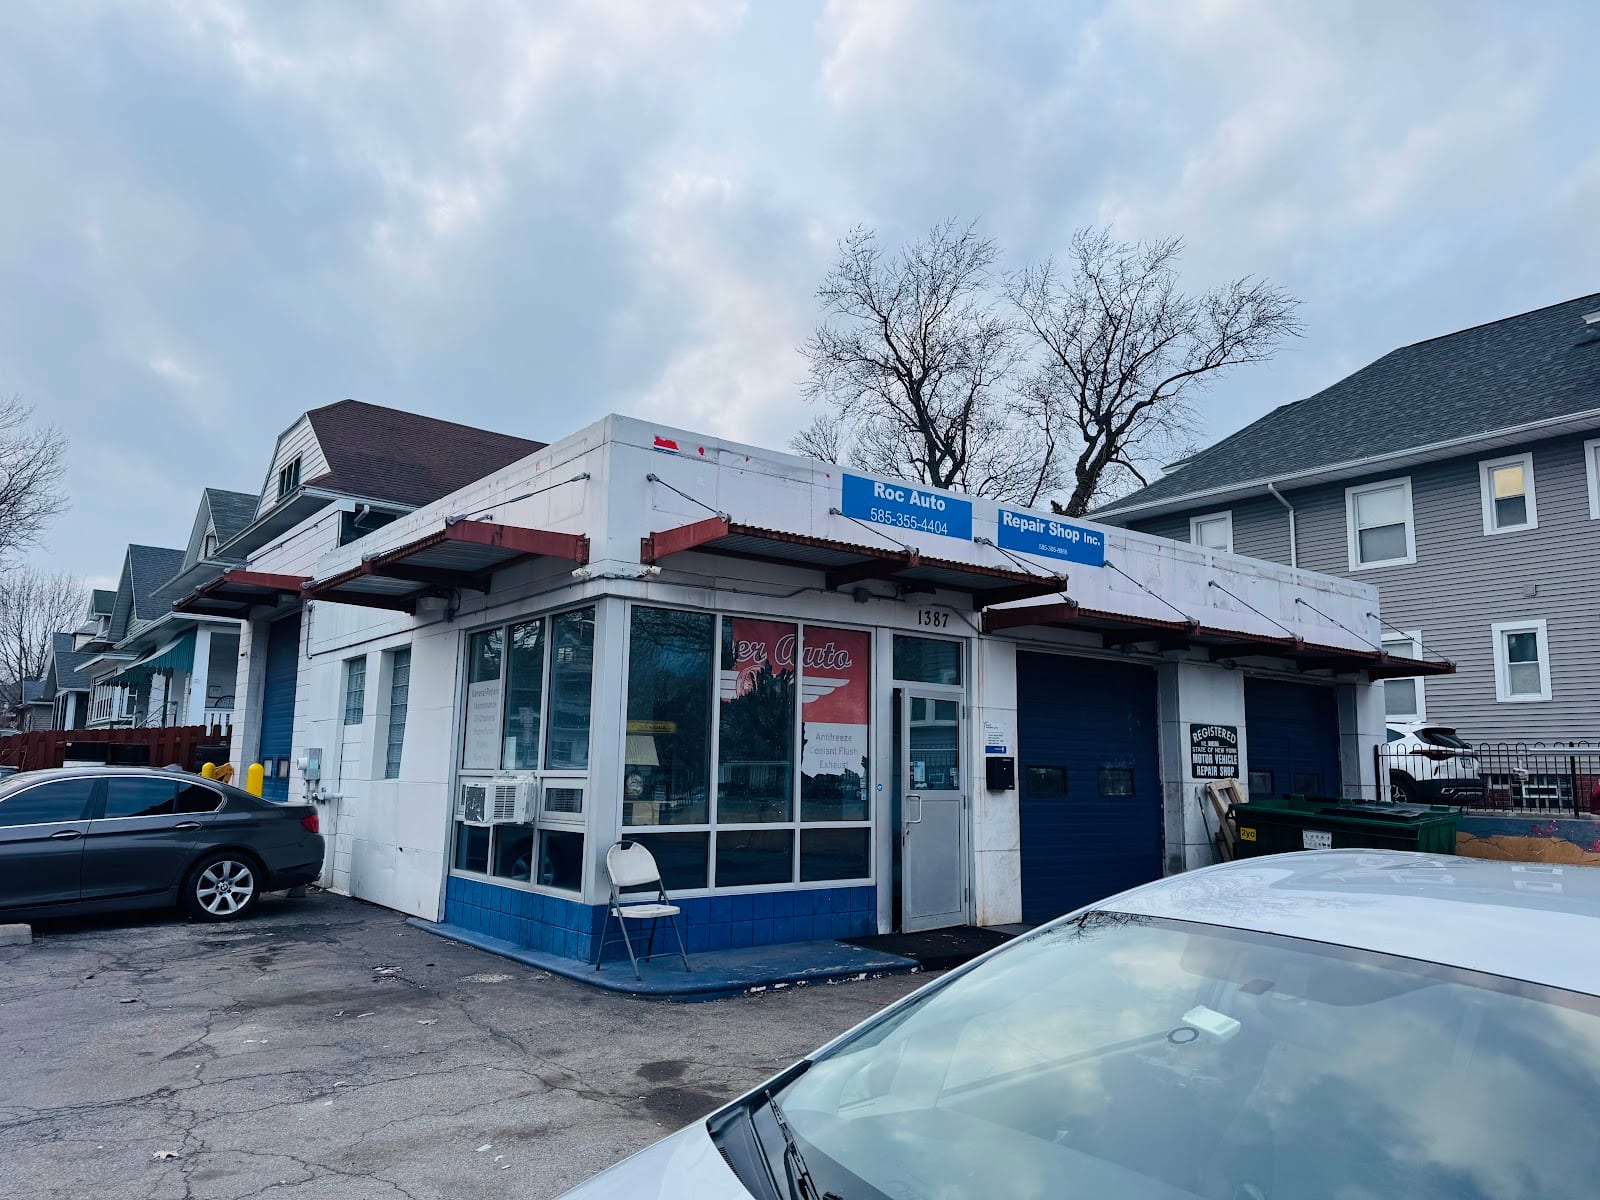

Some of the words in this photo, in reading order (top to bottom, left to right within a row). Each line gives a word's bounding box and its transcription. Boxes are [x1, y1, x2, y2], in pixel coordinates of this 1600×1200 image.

[874, 481, 905, 503] Roc
[909, 490, 946, 511] Auto
[870, 507, 948, 535] 585-355-4404
[1003, 511, 1046, 534] Repair
[1049, 521, 1080, 543] Shop
[1083, 532, 1101, 546] Inc.
[918, 609, 949, 628] 1387
[774, 633, 853, 671] Auto
[815, 732, 853, 742] Antifreeze
[1192, 725, 1237, 744] REGISTERED
[838, 746, 858, 756] Flush
[1192, 753, 1213, 765] MOTOR
[1215, 754, 1238, 765] VEHICLE
[819, 760, 849, 769] Exhaust
[1196, 765, 1218, 777] REPAIR
[1219, 766, 1235, 777] SHOP
